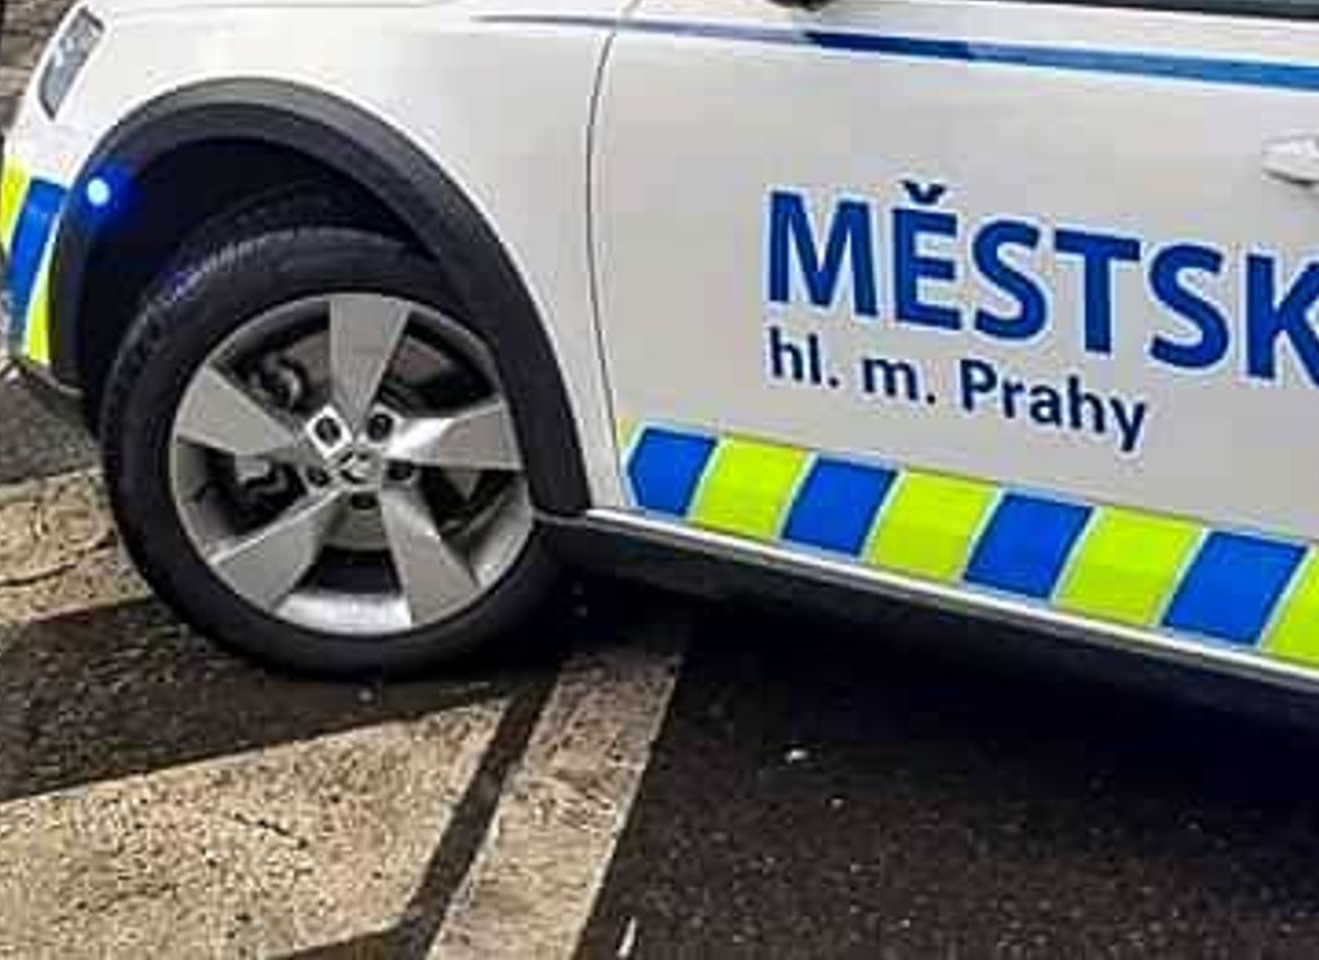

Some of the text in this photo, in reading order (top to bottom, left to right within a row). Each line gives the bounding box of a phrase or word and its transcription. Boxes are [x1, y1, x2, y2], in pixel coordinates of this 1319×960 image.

[771, 327, 1147, 452] hl. m. Prahy
